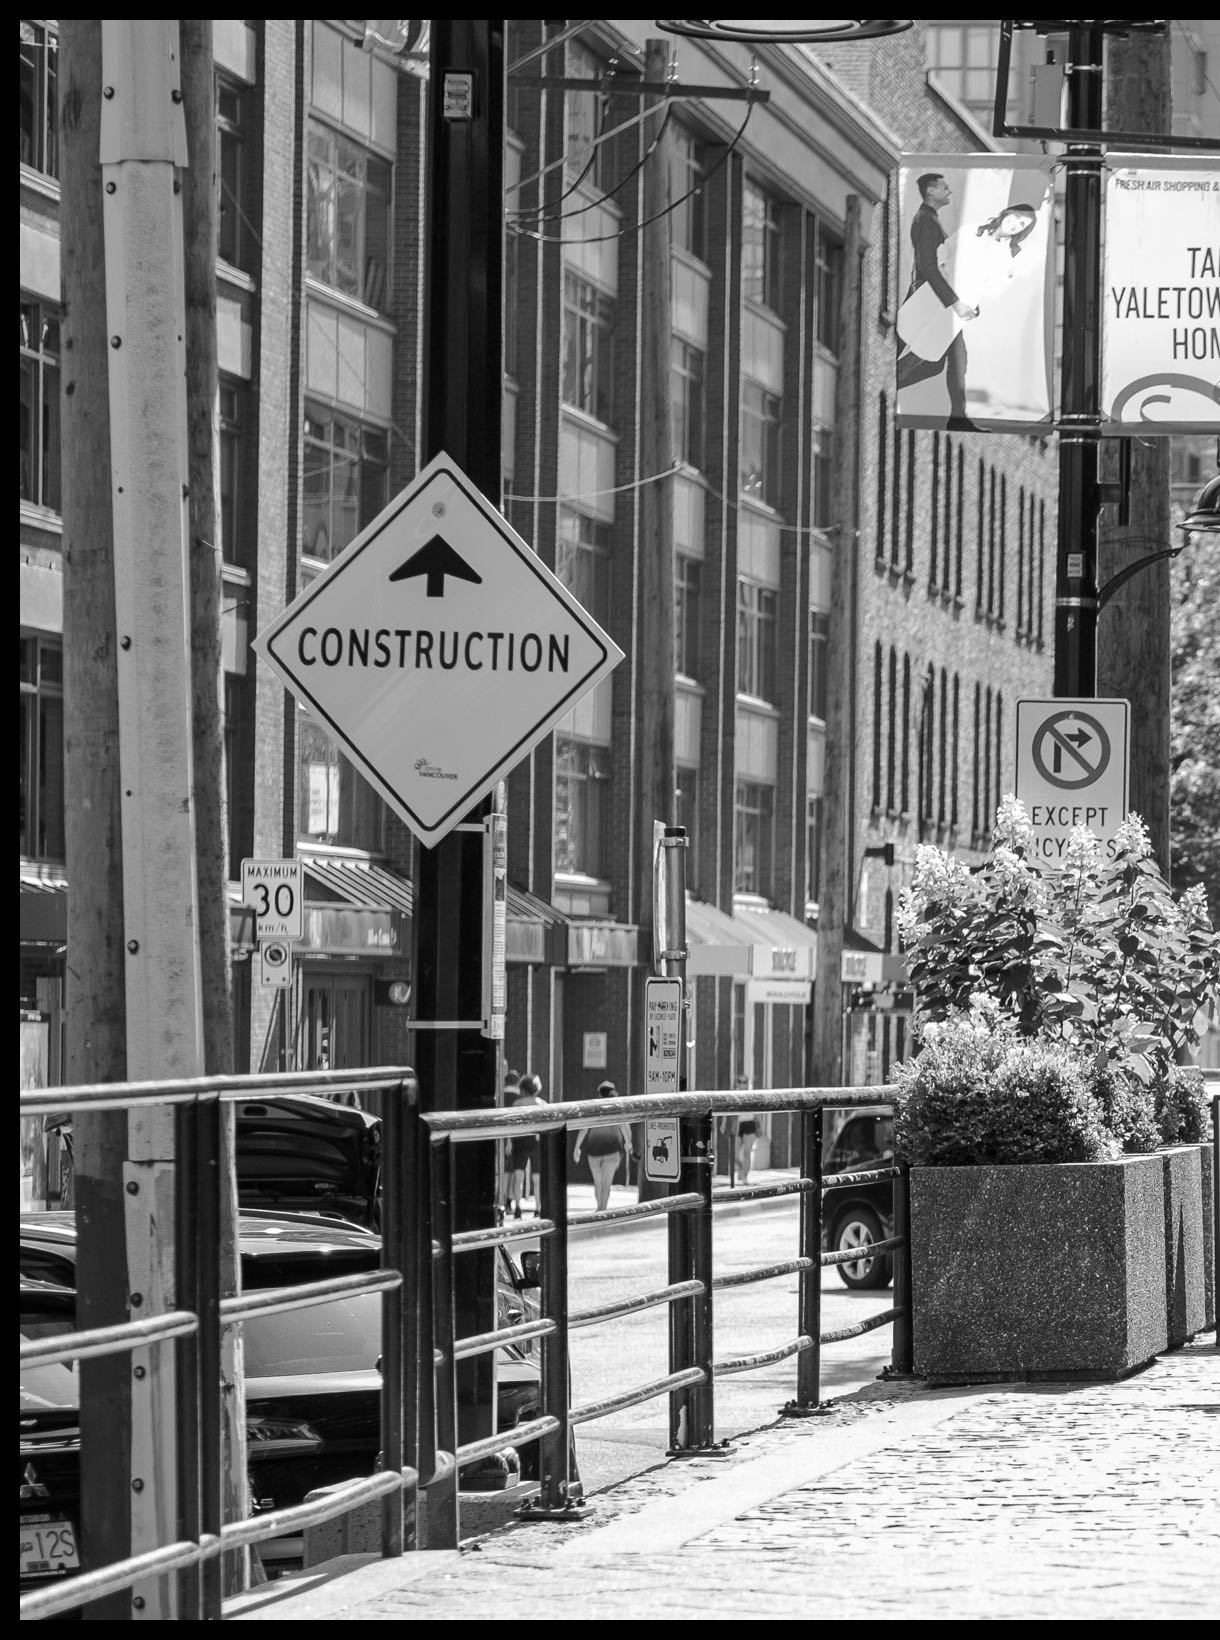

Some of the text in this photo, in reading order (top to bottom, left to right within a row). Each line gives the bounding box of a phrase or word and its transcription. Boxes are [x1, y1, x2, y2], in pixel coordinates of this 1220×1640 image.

[1115, 179, 1144, 190] FRESH
[1146, 180, 1161, 190] AIR
[1163, 181, 1210, 192] SHOPPING
[1212, 182, 1220, 191] &
[298, 627, 570, 672] CONSTRUCTION
[1032, 805, 1108, 827] EXCEPT
[247, 865, 298, 878] MAXIMUM
[253, 884, 294, 917] 30
[258, 922, 288, 932] km/h
[35, 1530, 75, 1559] 12S
